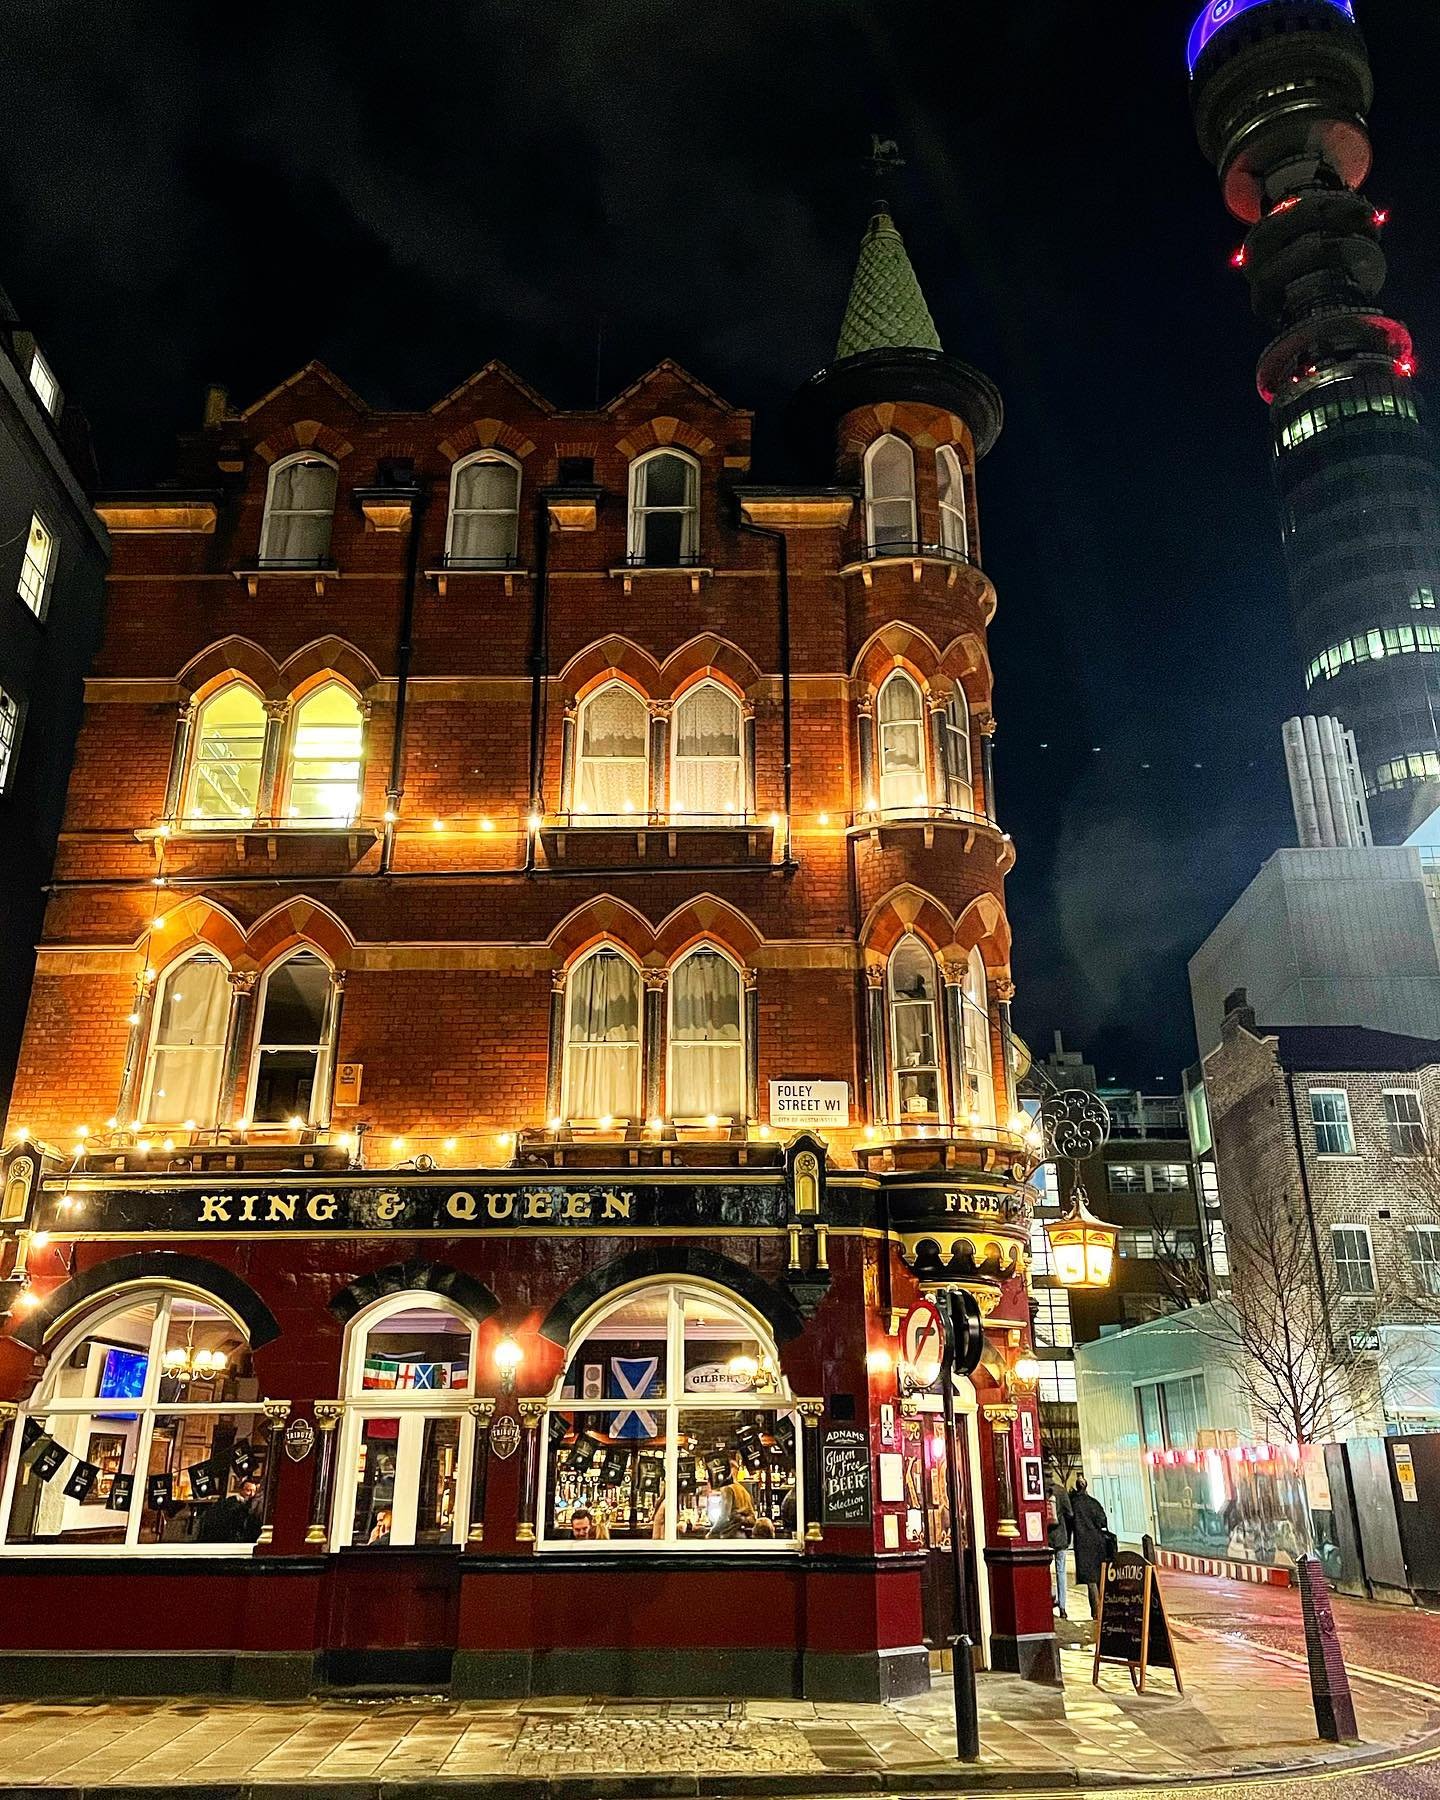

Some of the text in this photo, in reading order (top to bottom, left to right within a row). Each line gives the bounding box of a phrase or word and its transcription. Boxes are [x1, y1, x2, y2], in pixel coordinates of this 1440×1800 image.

[1215, 1, 1228, 16] BT
[778, 1085, 812, 1097] FOLEY
[778, 1099, 841, 1111] STREET W1
[197, 1191, 634, 1222] KING & QUEEN
[944, 1193, 1000, 1215] FREE
[826, 1430, 865, 1442] ADNAMS
[825, 1450, 856, 1472] Gluten
[838, 1460, 861, 1477] free
[827, 1473, 867, 1497] BEER
[1107, 1562, 1143, 1582] 6 NATIONS
